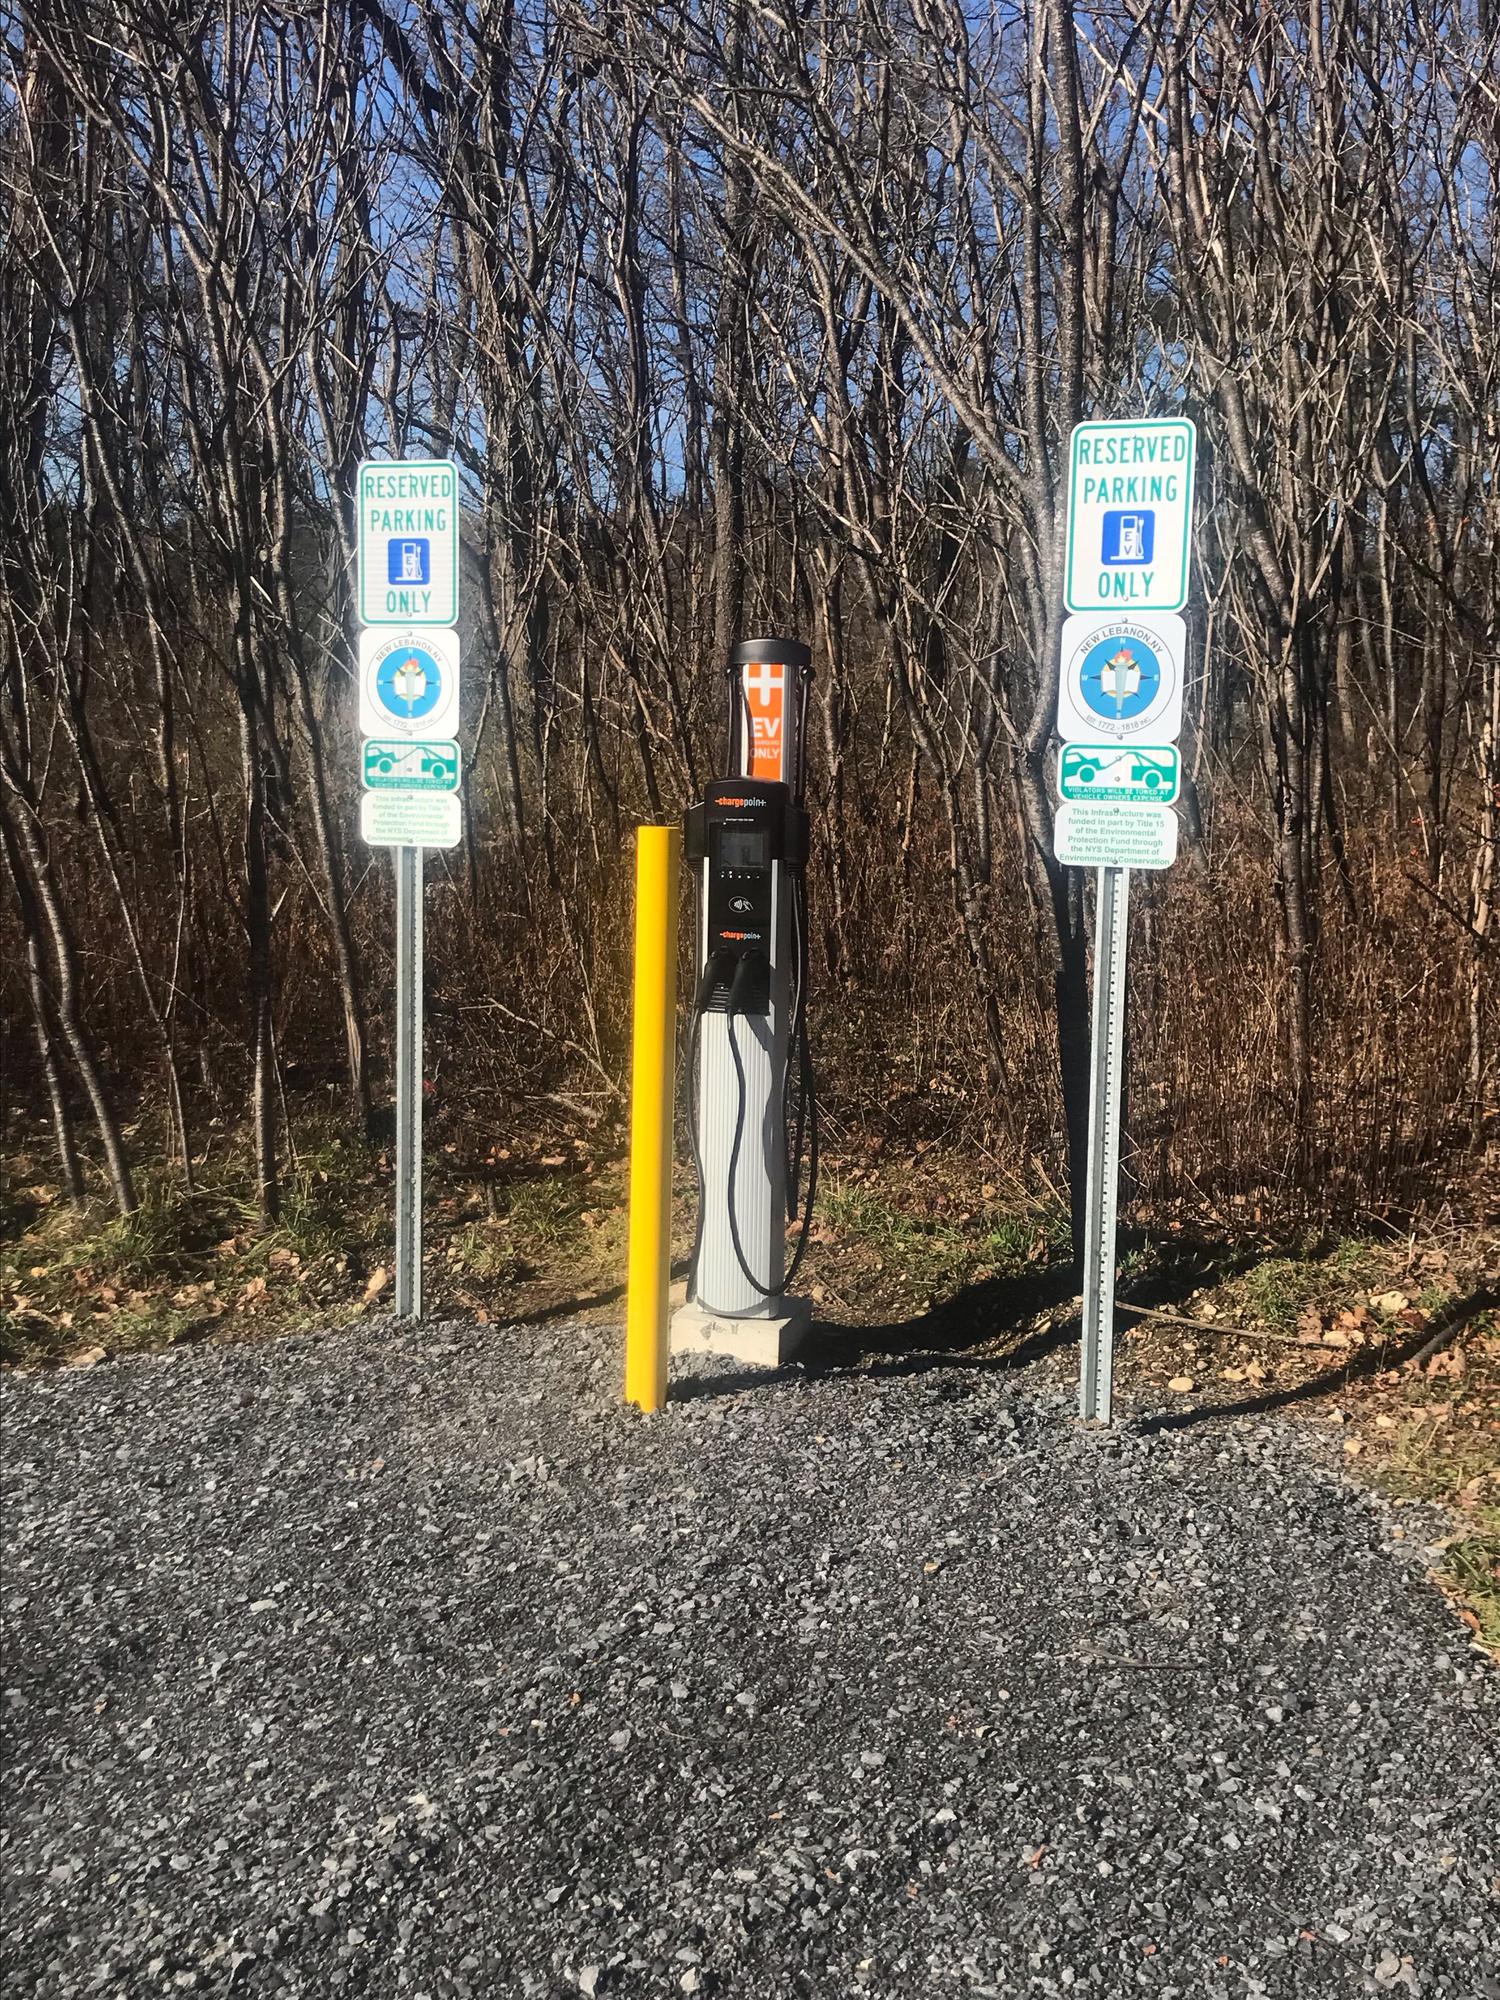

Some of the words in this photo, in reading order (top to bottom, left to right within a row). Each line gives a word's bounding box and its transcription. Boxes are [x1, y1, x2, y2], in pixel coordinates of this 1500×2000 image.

[1079, 435, 1186, 465] RESERVED
[365, 475, 451, 498] RESERVED
[1083, 475, 1178, 504] PARKING
[371, 509, 447, 532] PARKING
[1099, 571, 1155, 598] ONLY
[386, 591, 432, 613] ONLY
[376, 644, 392, 662] NEW
[1081, 634, 1100, 654] NEW
[1150, 640, 1163, 653] NY
[753, 717, 780, 738] EV
[1098, 720, 1115, 731] 1772
[750, 747, 779, 759] ONLY
[1072, 808, 1088, 816] This
[1068, 817, 1096, 825] funded
[1107, 818, 1123, 827] part
[1125, 819, 1134, 828] by
[1136, 819, 1153, 827] Title
[1155, 820, 1165, 828] 15
[1075, 826, 1083, 834] of
[1100, 827, 1156, 837] Environmental
[1067, 836, 1109, 844] Protection
[1111, 837, 1130, 845] Fund
[1132, 838, 1163, 847] through
[1070, 845, 1083, 853] the
[1085, 845, 1102, 853] NYS
[1104, 846, 1149, 855] Department
[1151, 847, 1159, 856] of
[1118, 855, 1170, 866] Conservation
